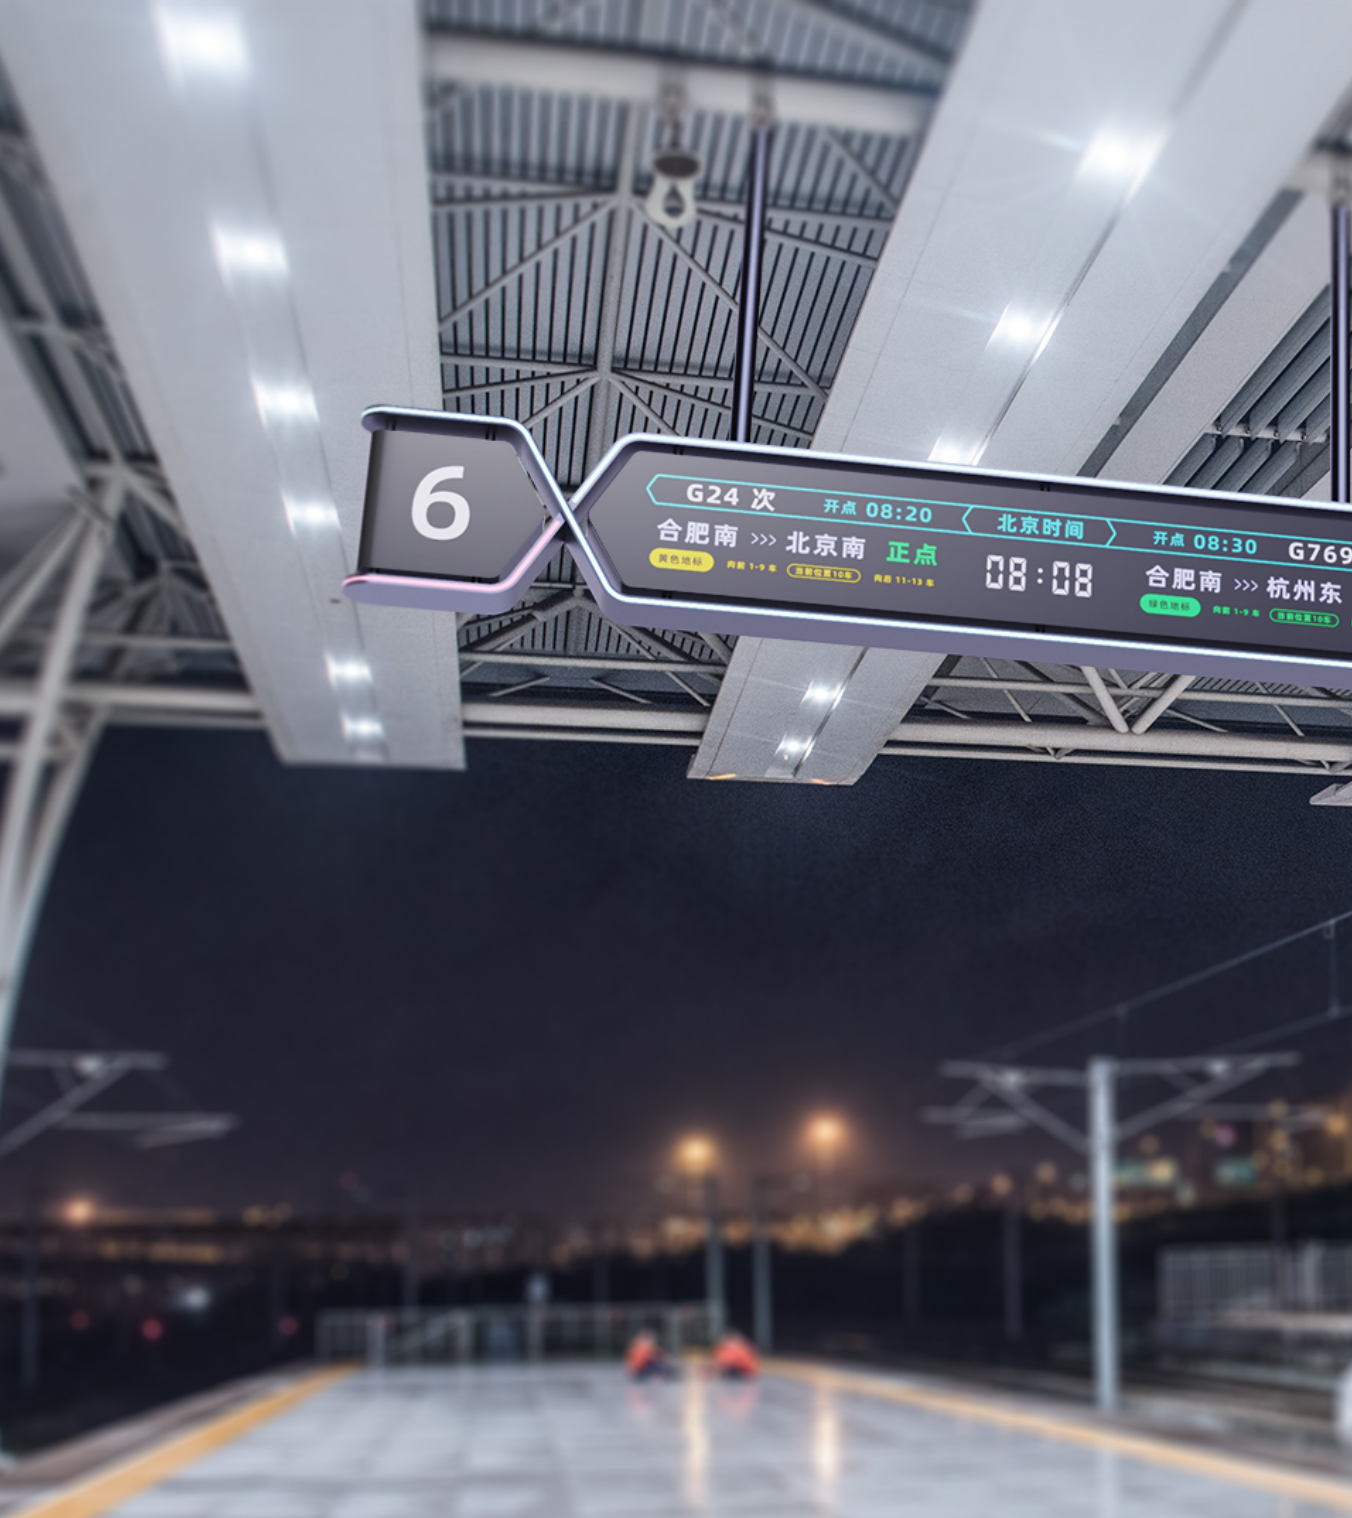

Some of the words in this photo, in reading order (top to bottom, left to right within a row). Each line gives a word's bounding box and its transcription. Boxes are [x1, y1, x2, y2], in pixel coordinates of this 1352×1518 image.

[410, 465, 471, 542] 6
[686, 483, 740, 506] G24
[750, 487, 777, 512] 次
[823, 498, 857, 516] 开点
[865, 501, 933, 523] 08:20
[656, 517, 739, 548] 合肥南
[785, 530, 867, 560] 北京南
[997, 513, 1085, 540] 北京时间
[886, 540, 938, 567] 正点
[1152, 530, 1185, 547] 开点
[1193, 533, 1258, 555] 08:30
[658, 553, 703, 567] 黄色地标
[985, 554, 1093, 598] 08:08
[1145, 564, 1222, 594] 合肥南
[1266, 576, 1343, 605] 杭州东
[1148, 599, 1191, 612] 绿色地标
